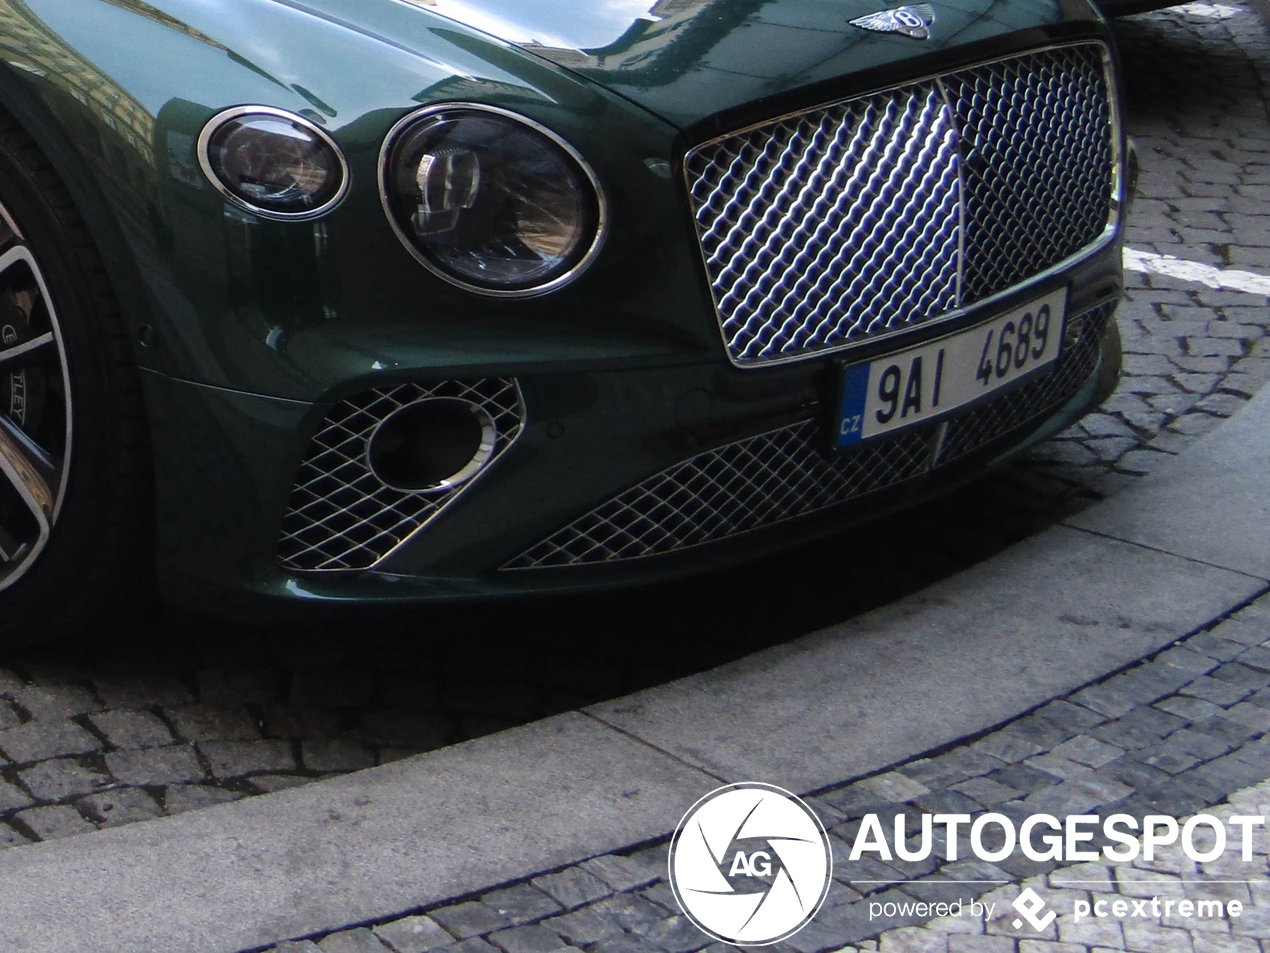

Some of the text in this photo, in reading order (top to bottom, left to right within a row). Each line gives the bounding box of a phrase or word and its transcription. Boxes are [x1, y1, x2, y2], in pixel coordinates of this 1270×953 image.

[875, 303, 1051, 424] 9AI 4689
[840, 414, 861, 435] CZ
